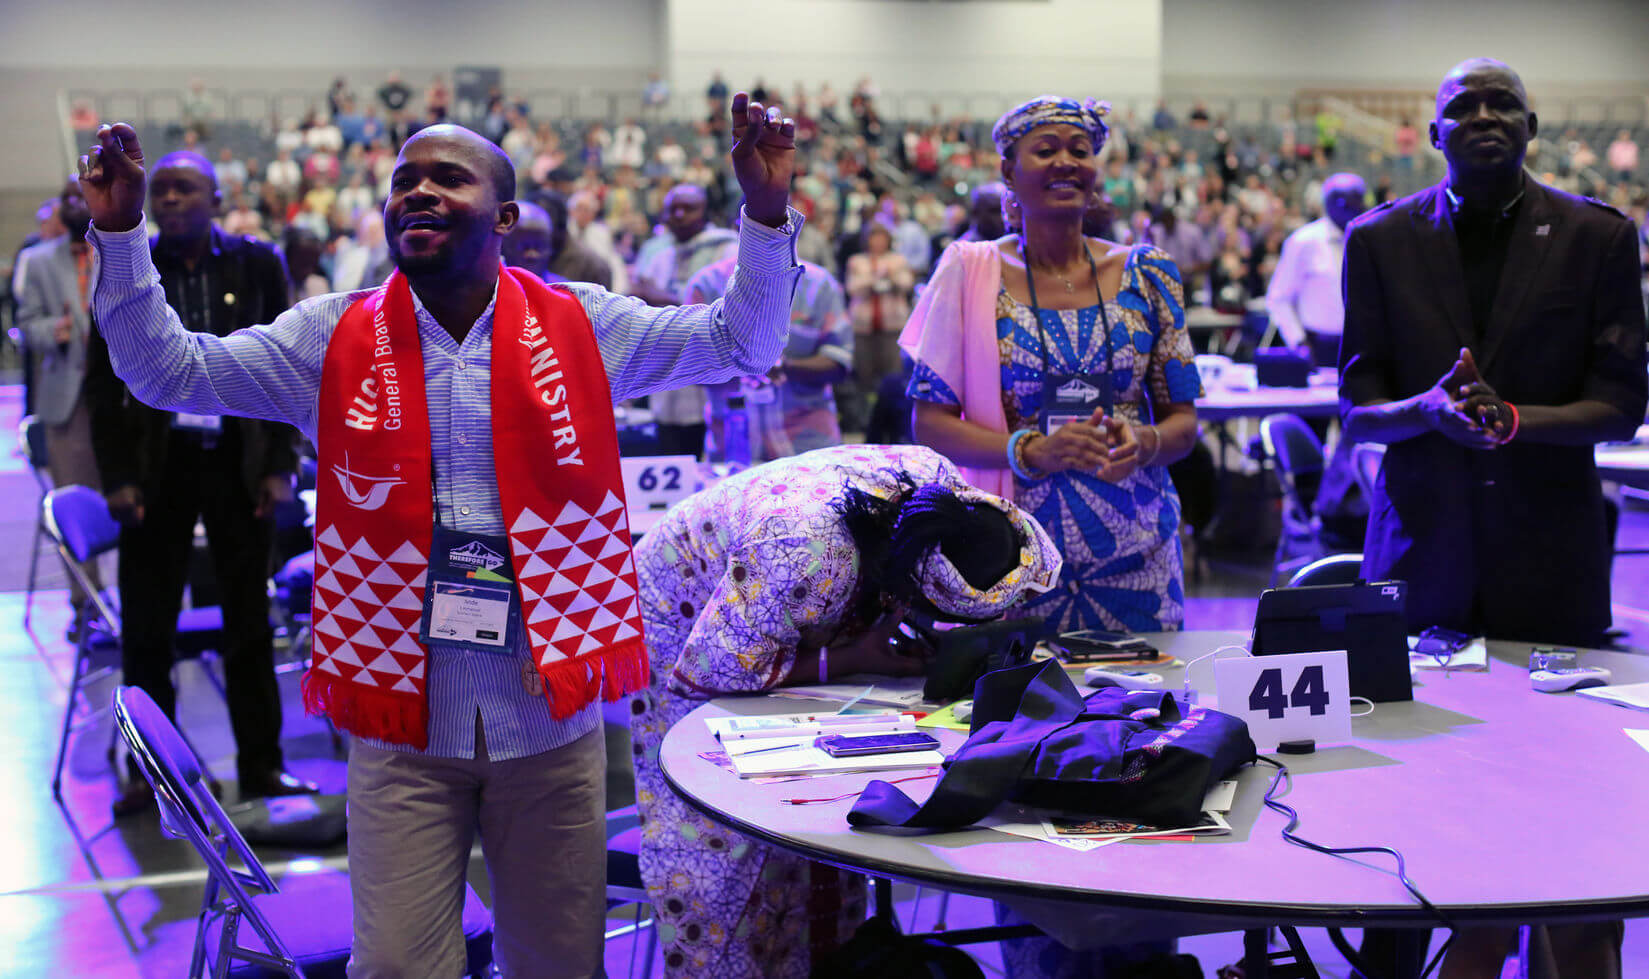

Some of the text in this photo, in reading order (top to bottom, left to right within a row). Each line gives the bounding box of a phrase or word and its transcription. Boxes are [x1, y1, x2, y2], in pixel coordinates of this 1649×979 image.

[383, 362, 402, 431] General
[639, 466, 681, 491] 62
[1248, 664, 1330, 720] 44
